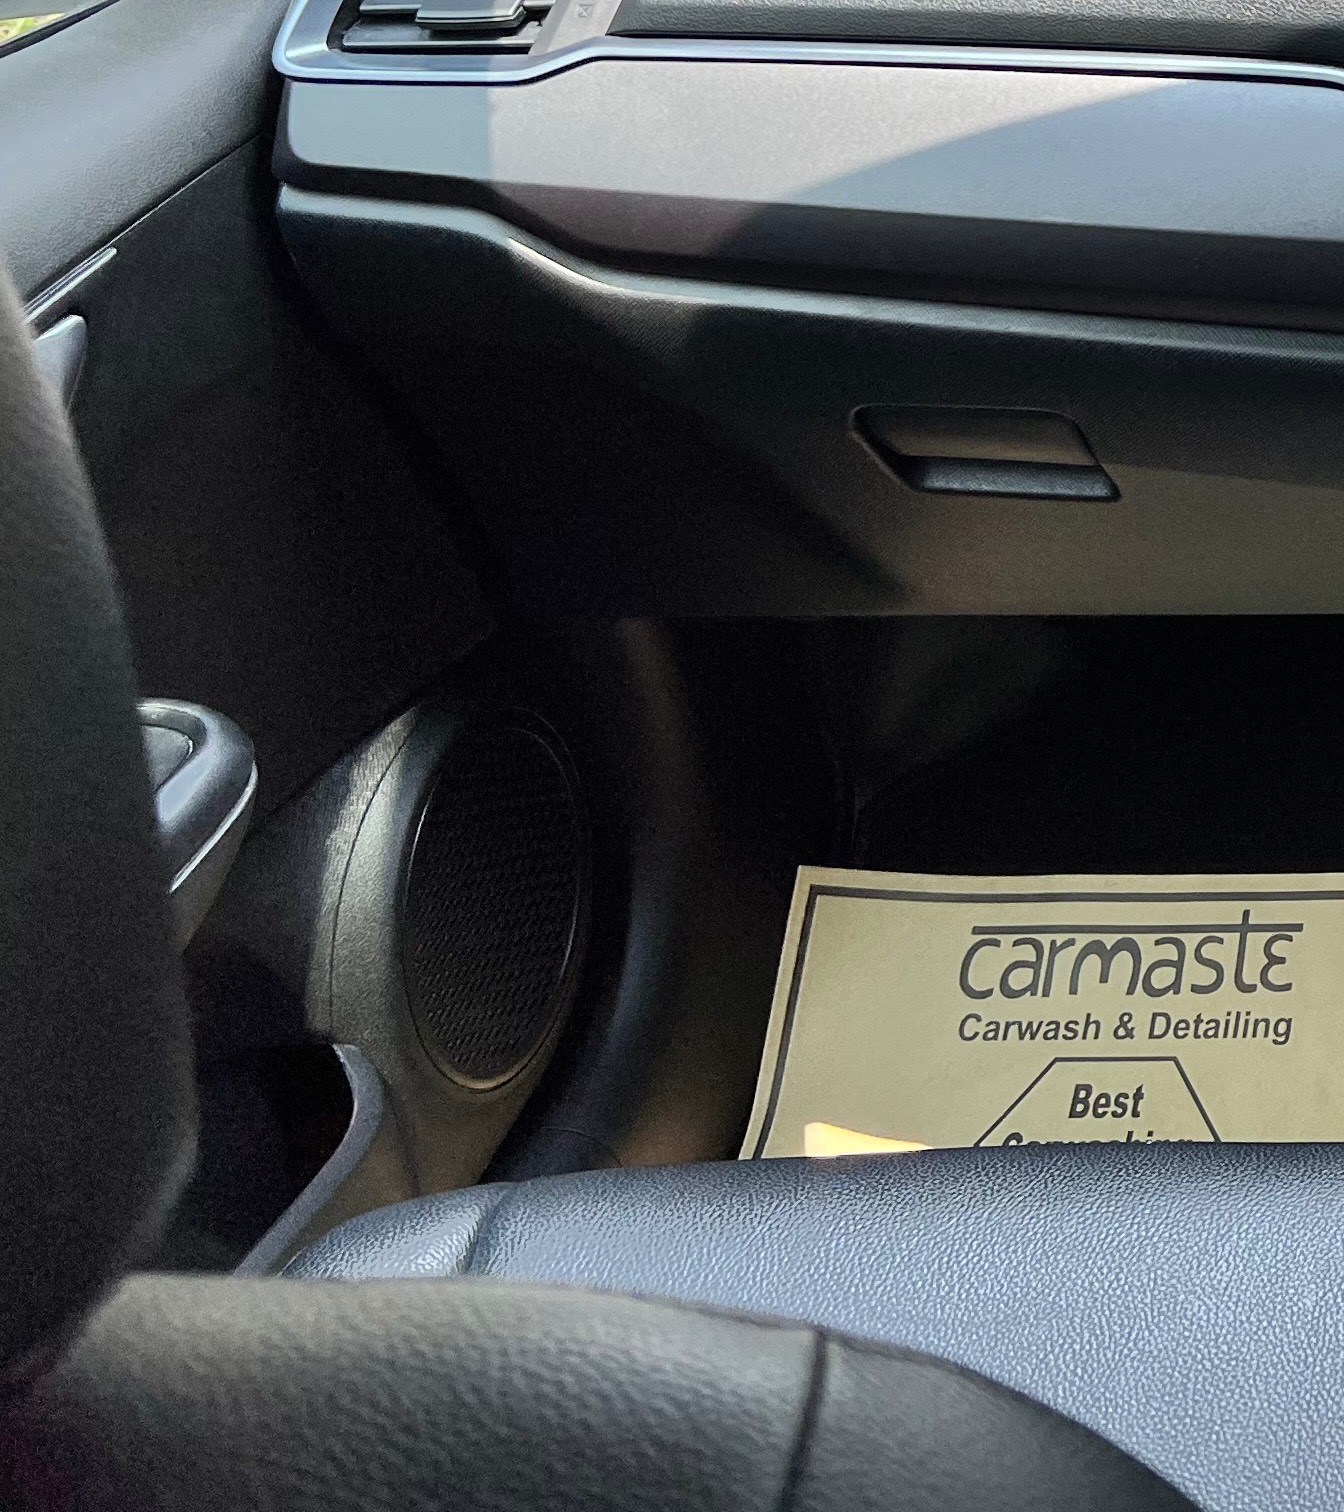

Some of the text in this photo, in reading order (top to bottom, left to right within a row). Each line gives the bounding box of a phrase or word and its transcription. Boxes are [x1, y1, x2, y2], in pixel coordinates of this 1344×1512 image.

[958, 1011, 1293, 1045] Carwash & Detailing
[1069, 1083, 1145, 1120] Best
